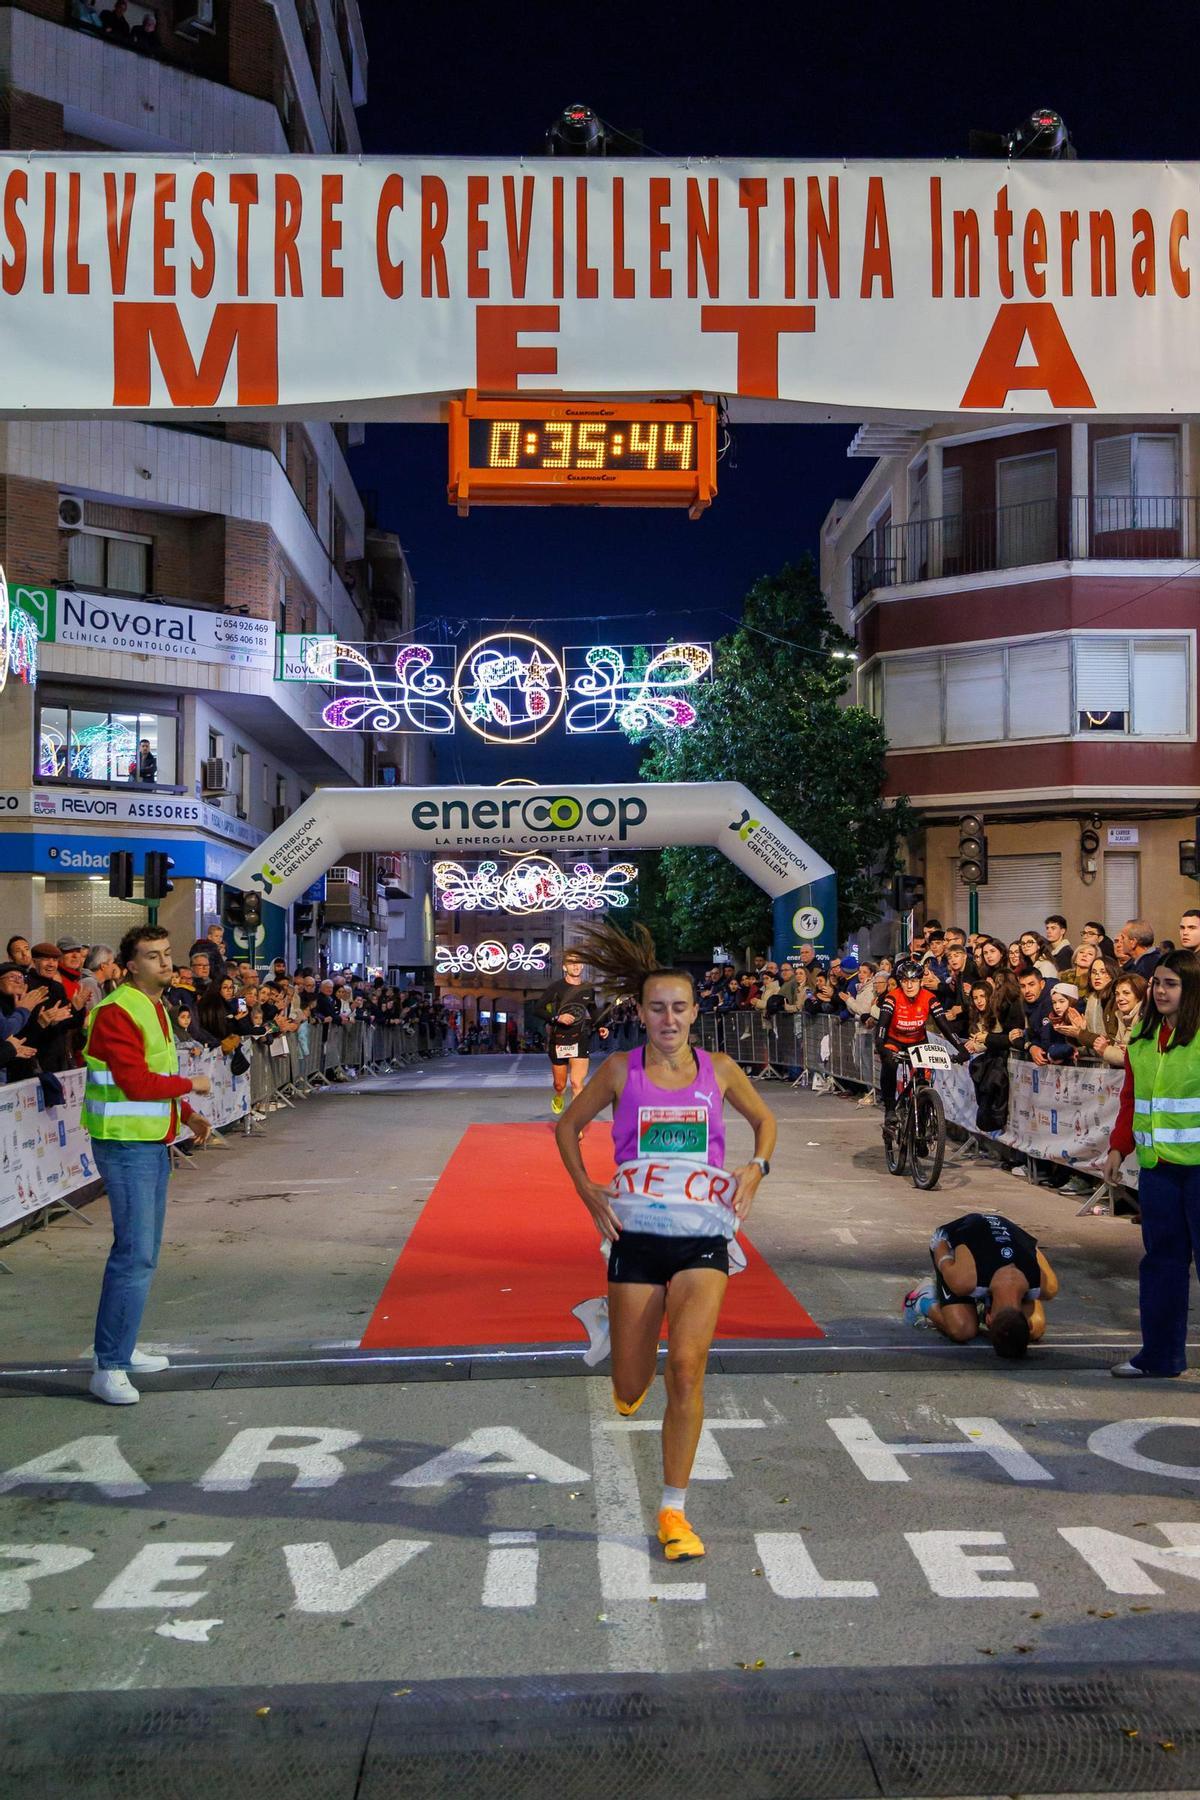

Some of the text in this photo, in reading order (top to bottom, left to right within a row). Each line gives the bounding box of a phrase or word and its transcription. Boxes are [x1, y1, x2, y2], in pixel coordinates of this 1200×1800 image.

[2, 169, 1190, 299] SILVESTRE CREVILLENTINA Internac
[490, 422, 693, 469] 0:35:44
[64, 598, 197, 642] Novoral
[223, 619, 269, 633] 654 926 469
[62, 631, 197, 655] CLÍNICA ODONTOLÓGICA
[225, 634, 267, 646] 965 406 181
[61, 798, 199, 819] REVOR ASESORES
[411, 796, 648, 840] enercoop
[283, 837, 324, 877] CREVILLENT
[435, 834, 615, 845] LA ENERGÍA COOPERATIVA
[747, 840, 788, 879] CREVILLENT
